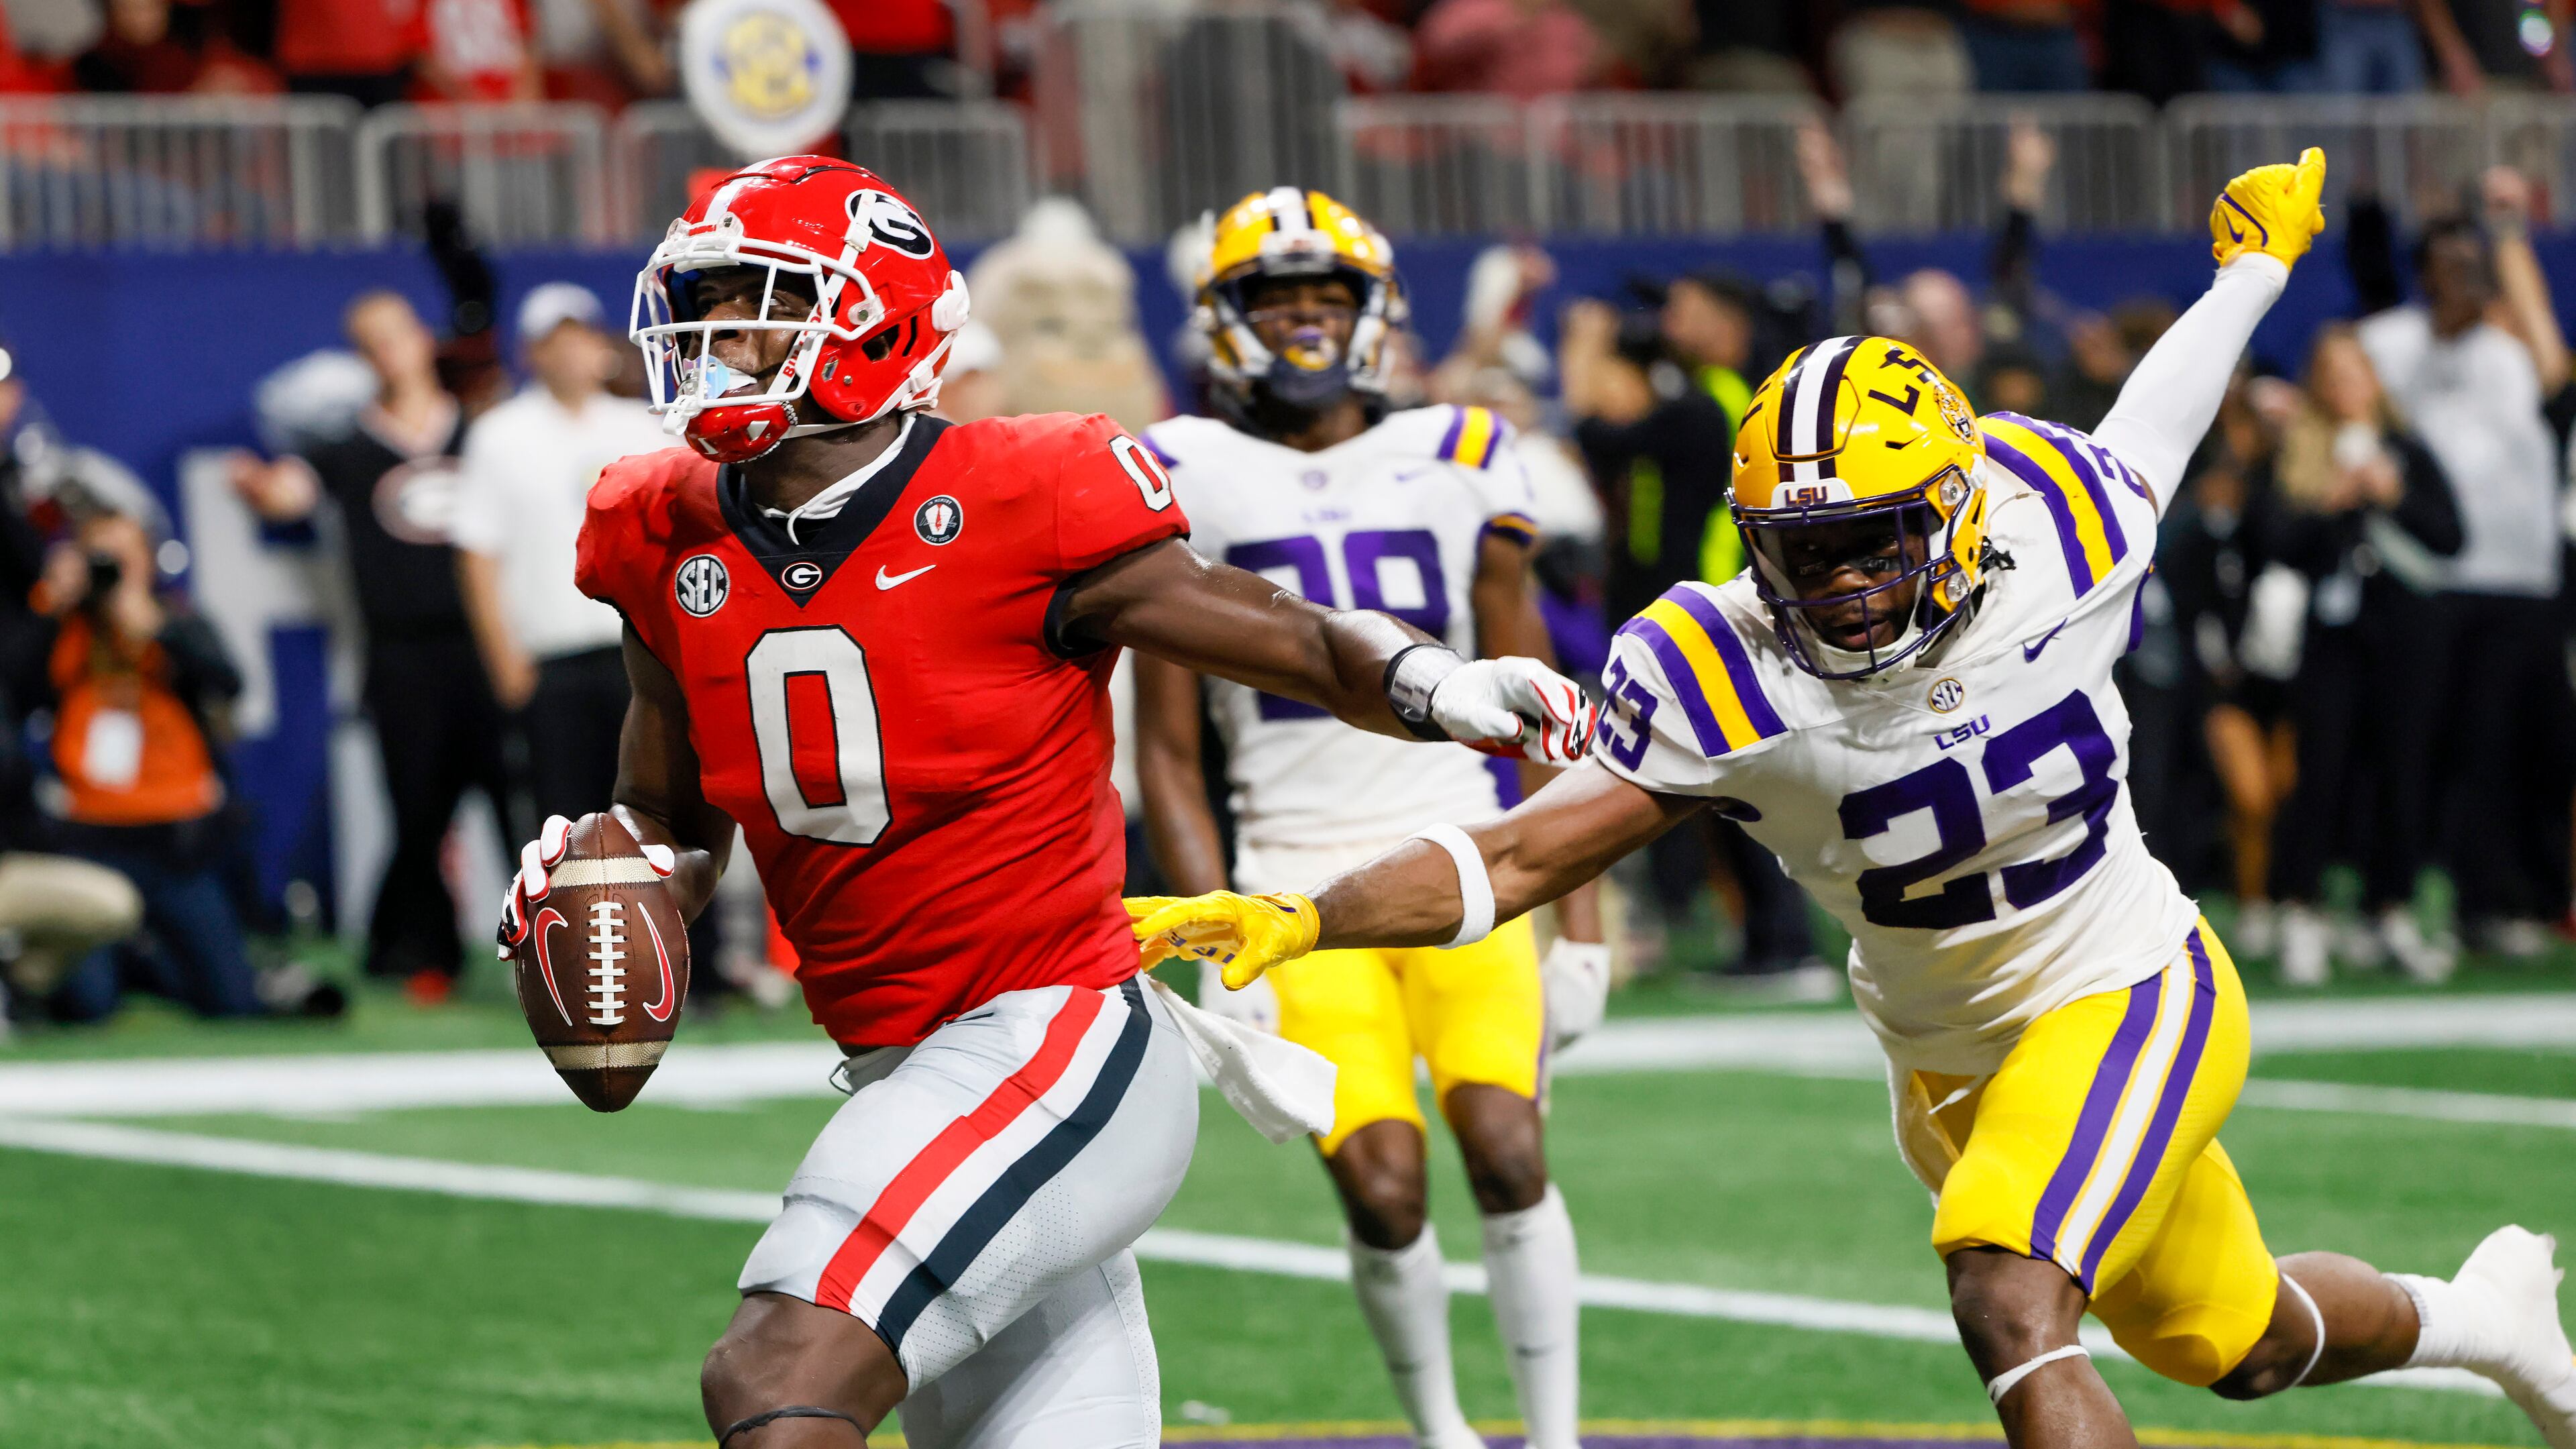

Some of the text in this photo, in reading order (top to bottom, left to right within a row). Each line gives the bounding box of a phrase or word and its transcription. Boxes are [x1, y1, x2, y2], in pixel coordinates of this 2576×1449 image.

[1108, 434, 1173, 513] 0
[1784, 486, 1828, 506] LSU
[678, 558, 725, 613] SEC
[1597, 655, 1658, 773] 23
[1931, 680, 1964, 711] SEC
[744, 624, 894, 847] 0
[1933, 714, 1990, 751] LSU
[1837, 688, 2118, 930] 23
